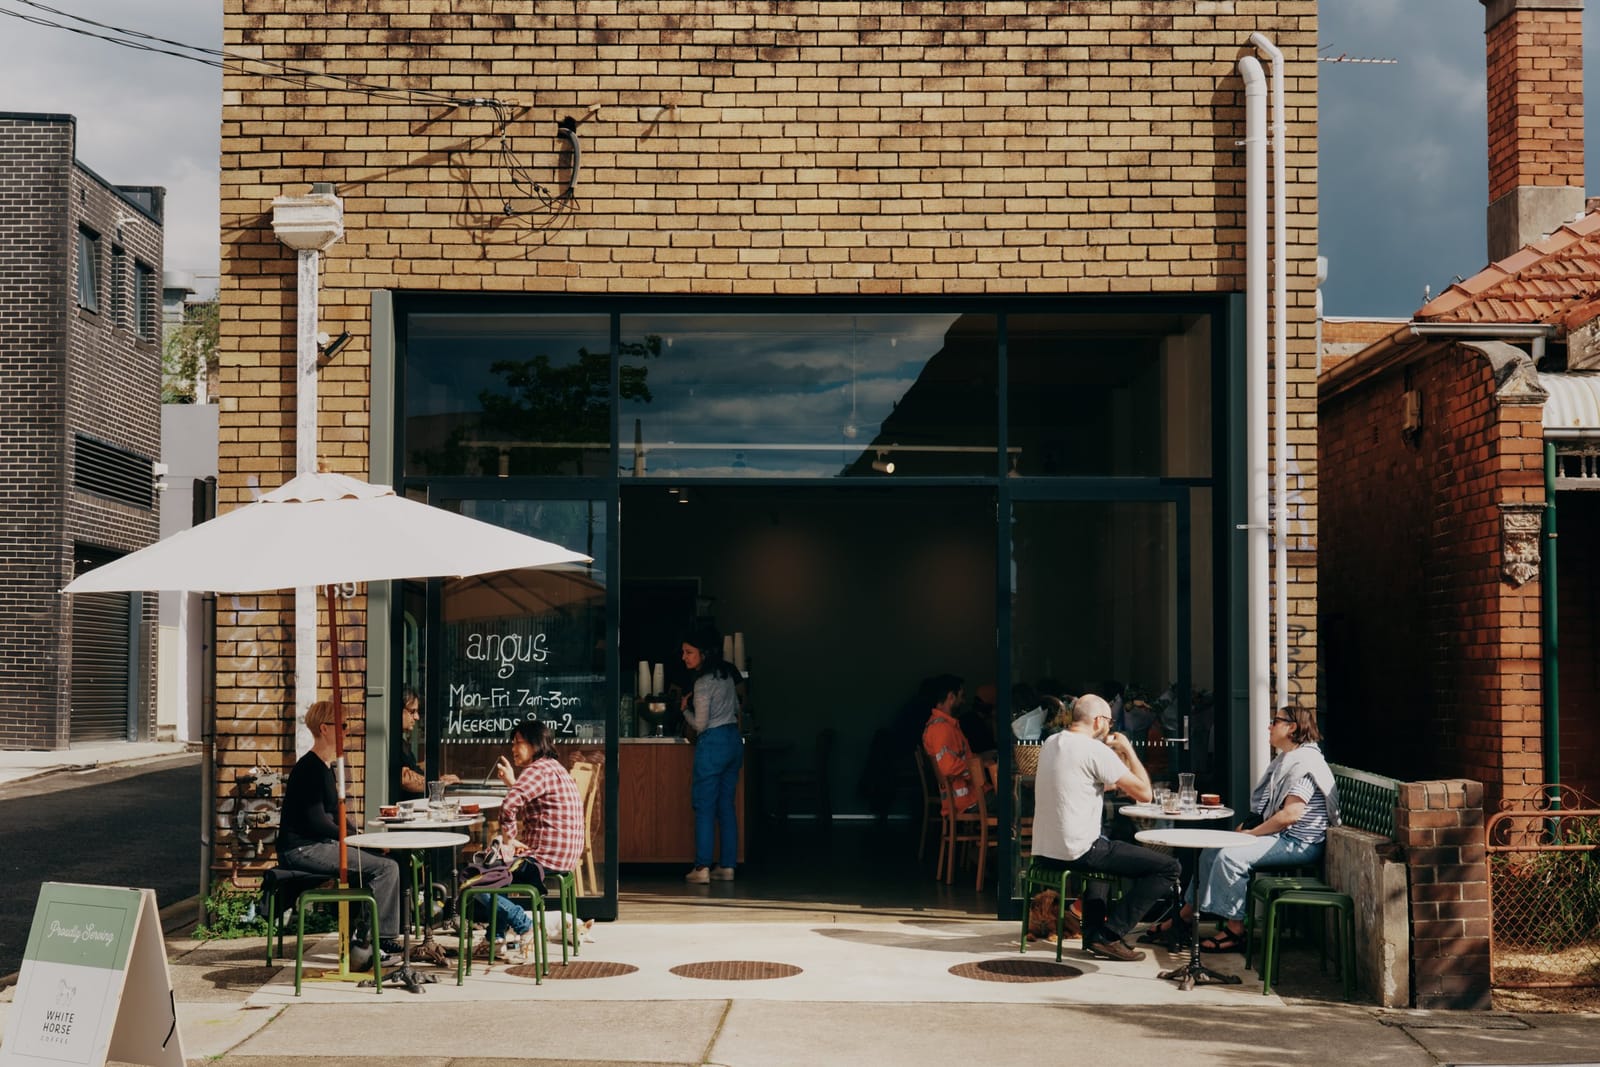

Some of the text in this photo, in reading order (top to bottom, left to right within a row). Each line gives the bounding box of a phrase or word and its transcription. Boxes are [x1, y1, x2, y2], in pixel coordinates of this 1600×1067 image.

[466, 633, 547, 679] angus
[449, 684, 510, 708] Mon-Fri
[47, 920, 115, 946] Proudly Serving
[46, 1010, 75, 1024] WHITE
[42, 1022, 72, 1035] HORSE
[40, 1035, 69, 1046] COFFEE
